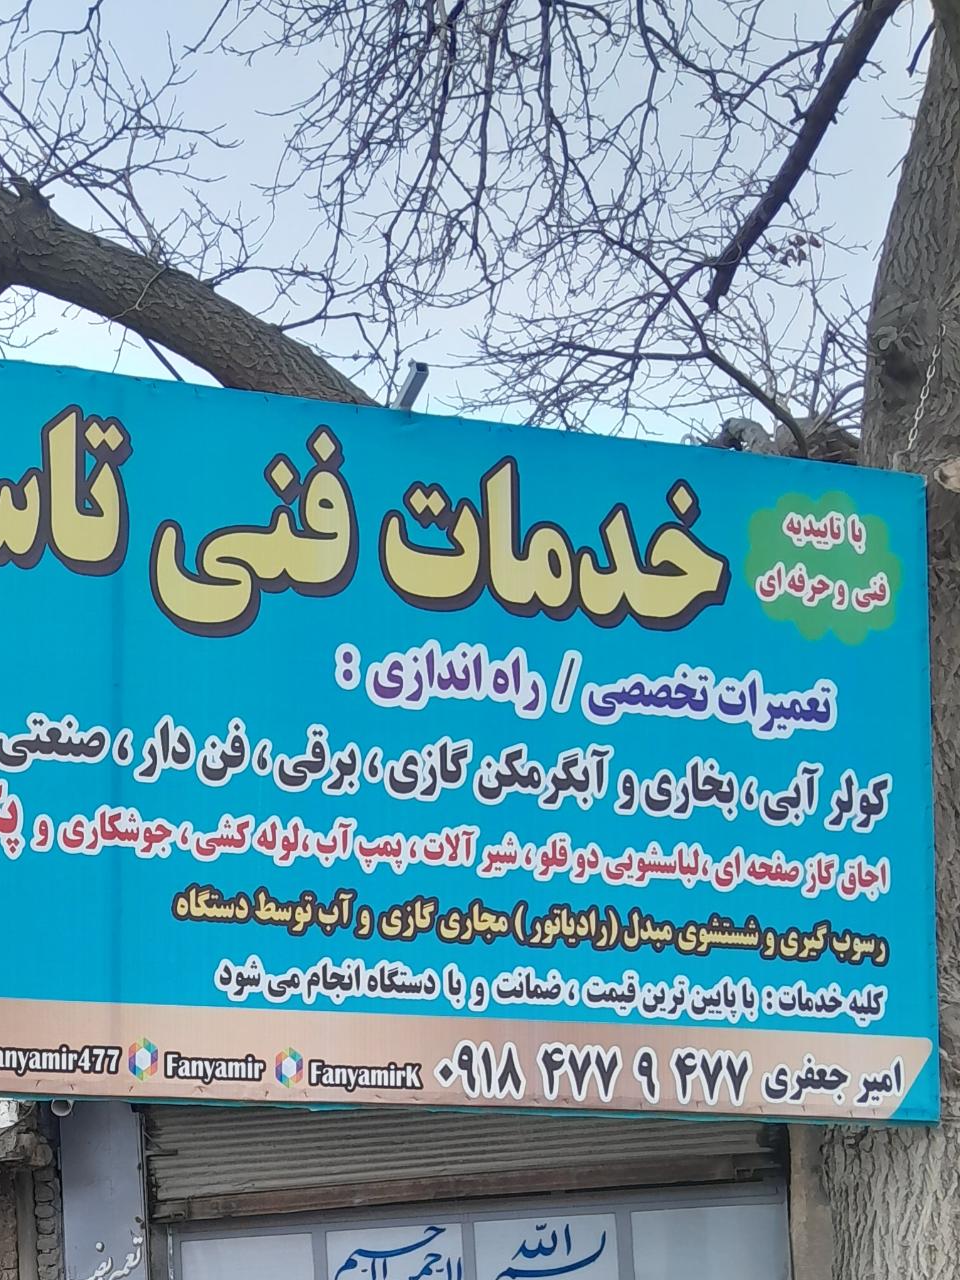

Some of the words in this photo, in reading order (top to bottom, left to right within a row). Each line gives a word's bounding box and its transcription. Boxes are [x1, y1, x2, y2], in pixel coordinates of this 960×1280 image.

[150, 424, 356, 636] فنی
[381, 456, 731, 632] خدمات
[785, 515, 842, 546] تاییدیه
[849, 517, 864, 551] با
[758, 566, 783, 598] ای
[787, 566, 831, 603] حرفه
[835, 582, 846, 606] و
[854, 575, 887, 608] فنی
[372, 646, 483, 703] اندازی
[492, 655, 539, 712] راه
[587, 669, 708, 717] تخصصی
[716, 679, 833, 733] تعمیرات
[138, 721, 192, 778] دار
[200, 721, 244, 782] فن
[278, 725, 358, 793] برقی
[388, 738, 469, 798] گازی
[477, 747, 614, 809] آبگرمکن
[618, 780, 636, 812] و
[643, 758, 737, 818] بخاری
[763, 762, 819, 824] آبی
[827, 774, 890, 829] کولر
[35, 817, 50, 847] و
[61, 806, 172, 853] جوشکاری
[196, 815, 250, 856] کشی
[256, 820, 299, 862] لوله
[316, 822, 354, 862] آب
[422, 830, 474, 866] آلات
[358, 834, 403, 870] پمپ
[481, 837, 519, 873] شیر
[539, 838, 571, 874] قلو
[573, 850, 600, 880] دو
[605, 846, 701, 885] لباسشویی
[714, 852, 741, 887] ای
[746, 858, 800, 882] صفحه
[806, 856, 838, 891] گاز
[840, 861, 889, 897] اجاق
[175, 886, 251, 921] دستگاه
[253, 888, 314, 933] توسط
[316, 891, 353, 932] آب
[380, 899, 438, 936] گازی
[439, 903, 510, 938] مجاری
[357, 910, 371, 935] و
[622, 910, 673, 950] مبدل
[676, 917, 761, 954] شستشوی
[778, 922, 828, 959] گیری
[763, 932, 776, 958] و
[831, 929, 889, 965] رسوب
[218, 958, 262, 996] شود
[267, 972, 301, 998] می
[305, 961, 362, 1002] انجام
[366, 963, 437, 996] دستگاه
[447, 966, 463, 1005] با
[472, 980, 486, 1007] و
[496, 970, 562, 1004] ضمانت
[586, 970, 637, 1012] قیمت
[642, 979, 686, 1016] ترین
[690, 981, 737, 1021] پایین
[740, 984, 757, 1018] با
[780, 983, 843, 1015] خدمات
[848, 989, 884, 1024] کلیه
[165, 1052, 266, 1086] Fanyamir
[438, 1043, 523, 1099] ۰۹۱۸
[541, 1047, 622, 1102] ۴۷۷
[673, 1049, 750, 1104] ۴۷۷
[763, 1056, 848, 1102] جعفری
[855, 1056, 906, 1105] امیر
